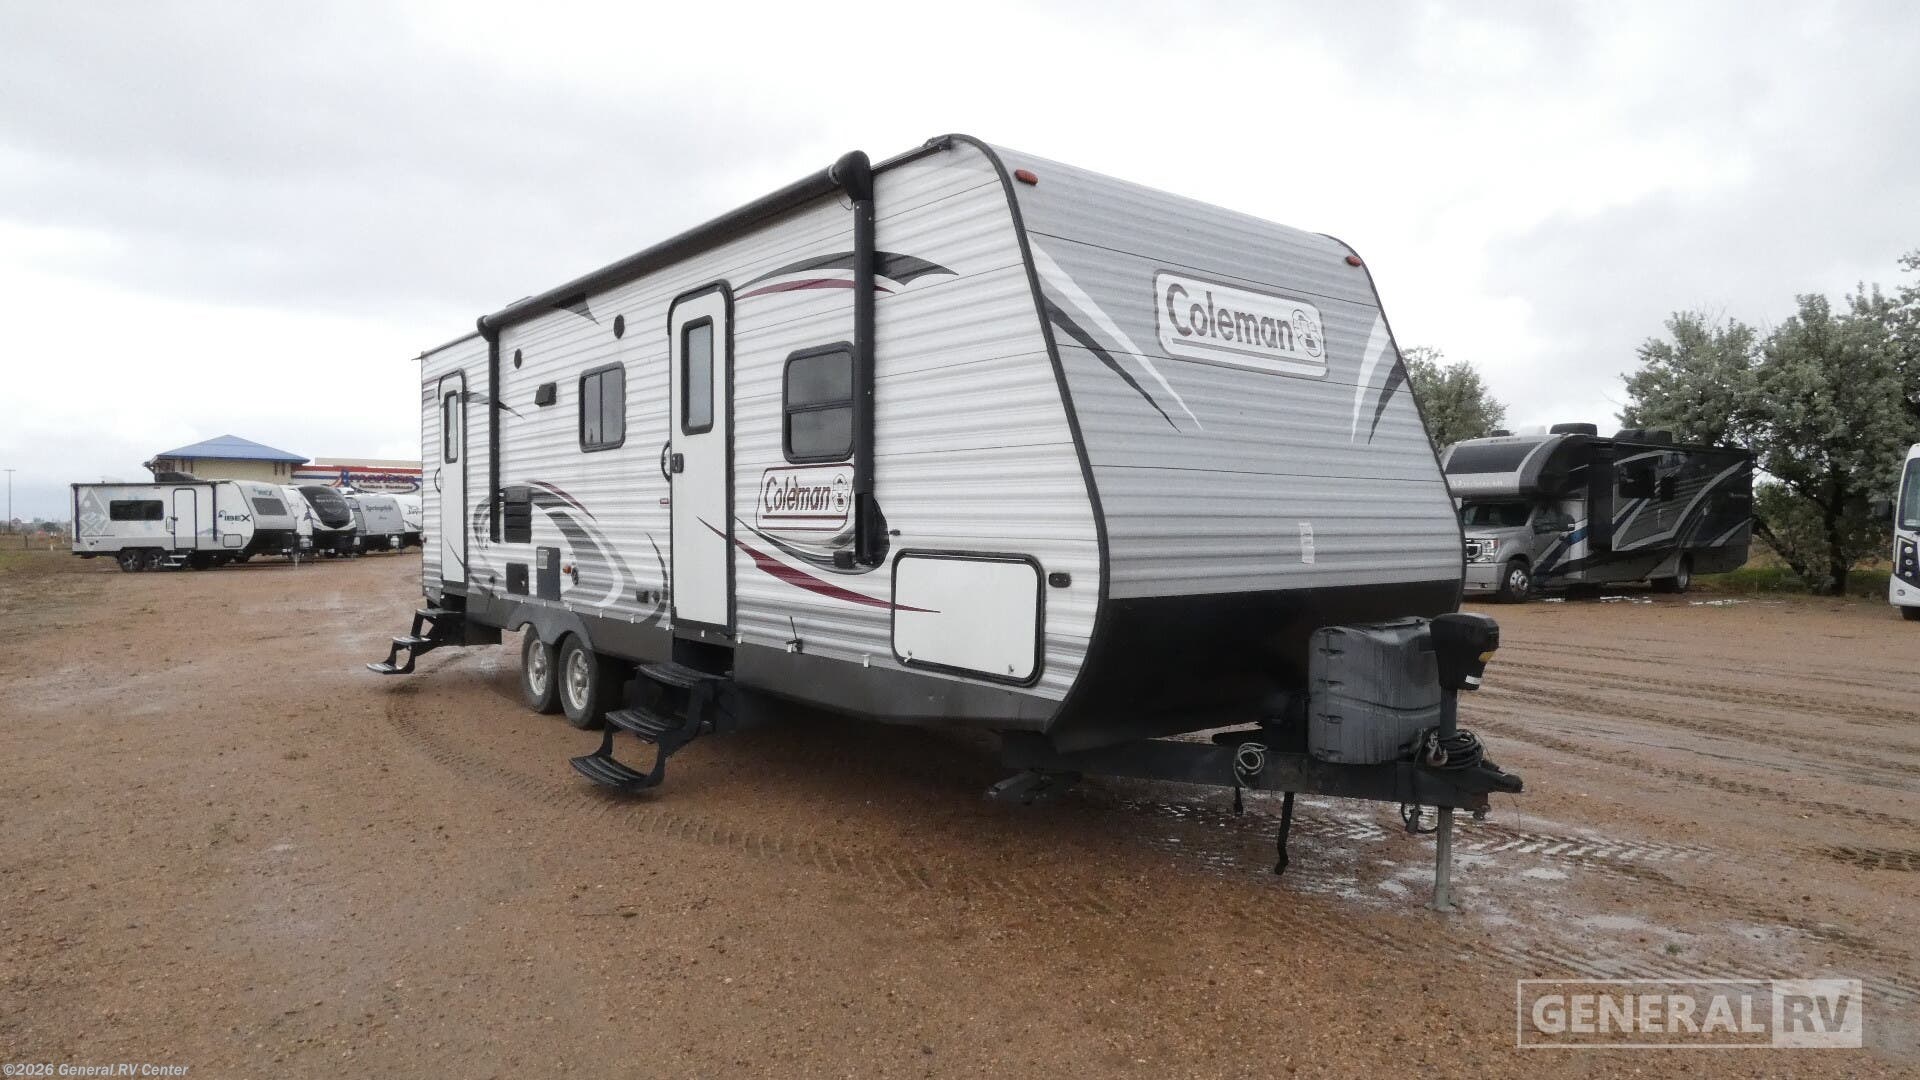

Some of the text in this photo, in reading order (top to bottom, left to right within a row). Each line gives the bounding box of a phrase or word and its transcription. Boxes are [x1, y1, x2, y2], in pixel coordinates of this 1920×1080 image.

[1166, 283, 1295, 351] Coleman
[764, 476, 831, 513] Coleman
[224, 514, 251, 522] IBEX
